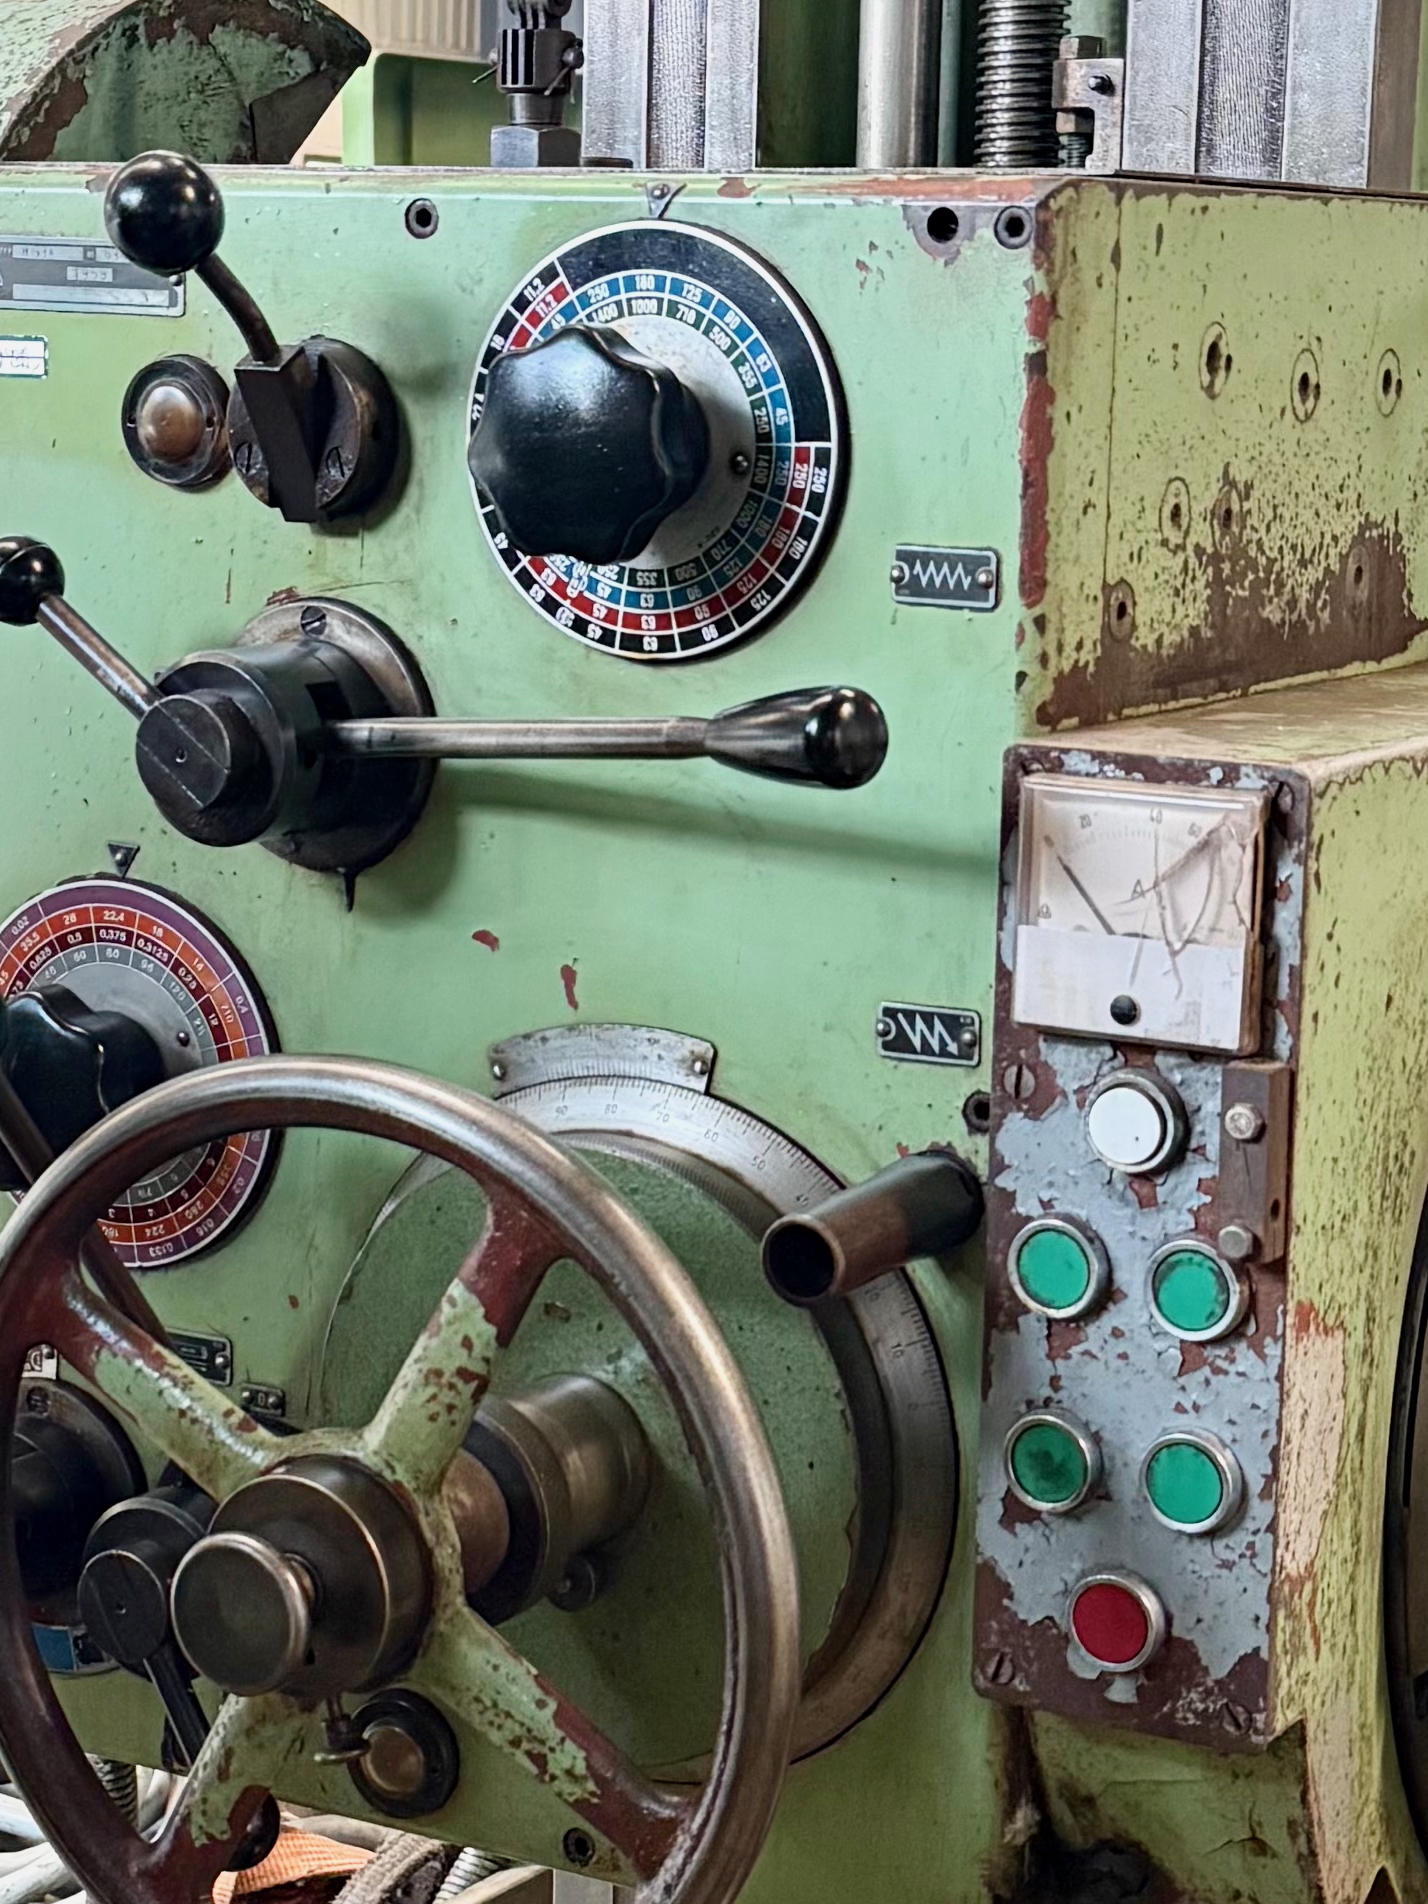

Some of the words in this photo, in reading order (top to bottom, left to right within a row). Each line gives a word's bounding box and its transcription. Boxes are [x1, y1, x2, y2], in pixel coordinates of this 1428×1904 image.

[524, 278, 545, 301] 11.2
[635, 274, 655, 291] 180
[587, 283, 609, 303] 250
[681, 283, 702, 303] 125
[535, 293, 558, 317] 11.2
[591, 303, 618, 324] 1400
[630, 299, 657, 314] 1000
[676, 305, 697, 325] 710
[708, 326, 732, 351] 500
[755, 355, 771, 372] 63
[738, 362, 757, 389] 355
[754, 407, 770, 434] 250
[775, 407, 789, 426] 45
[754, 454, 770, 484] 1400
[774, 461, 789, 486] 250
[792, 463, 809, 489] 250
[811, 467, 827, 493] 250
[738, 500, 758, 528] 1000
[494, 531, 509, 550] 45
[772, 527, 790, 549] 180
[711, 541, 732, 561] 710
[789, 536, 808, 560] 180
[723, 558, 743, 577] 125
[541, 568, 557, 587] 63
[636, 572, 658, 586] 355
[736, 574, 757, 595] 125
[529, 583, 546, 603] 63
[596, 582, 612, 600] 45
[687, 585, 703, 601] 90
[751, 590, 771, 611] 125
[640, 594, 655, 608] 63
[592, 603, 608, 620] 45
[587, 623, 602, 641] 45
[640, 615, 656, 630] 63
[643, 637, 658, 652] 63
[1131, 878, 1146, 899] A
[191, 956, 203, 971] 14
[168, 980, 186, 1001] 120
[655, 1111, 670, 1124] 70
[703, 1128, 719, 1143] 60
[750, 1156, 767, 1171] 50
[107, 1208, 116, 1218] 3
[147, 1208, 154, 1217] 4
[144, 1224, 165, 1238] 224
[891, 1343, 905, 1359] 10
